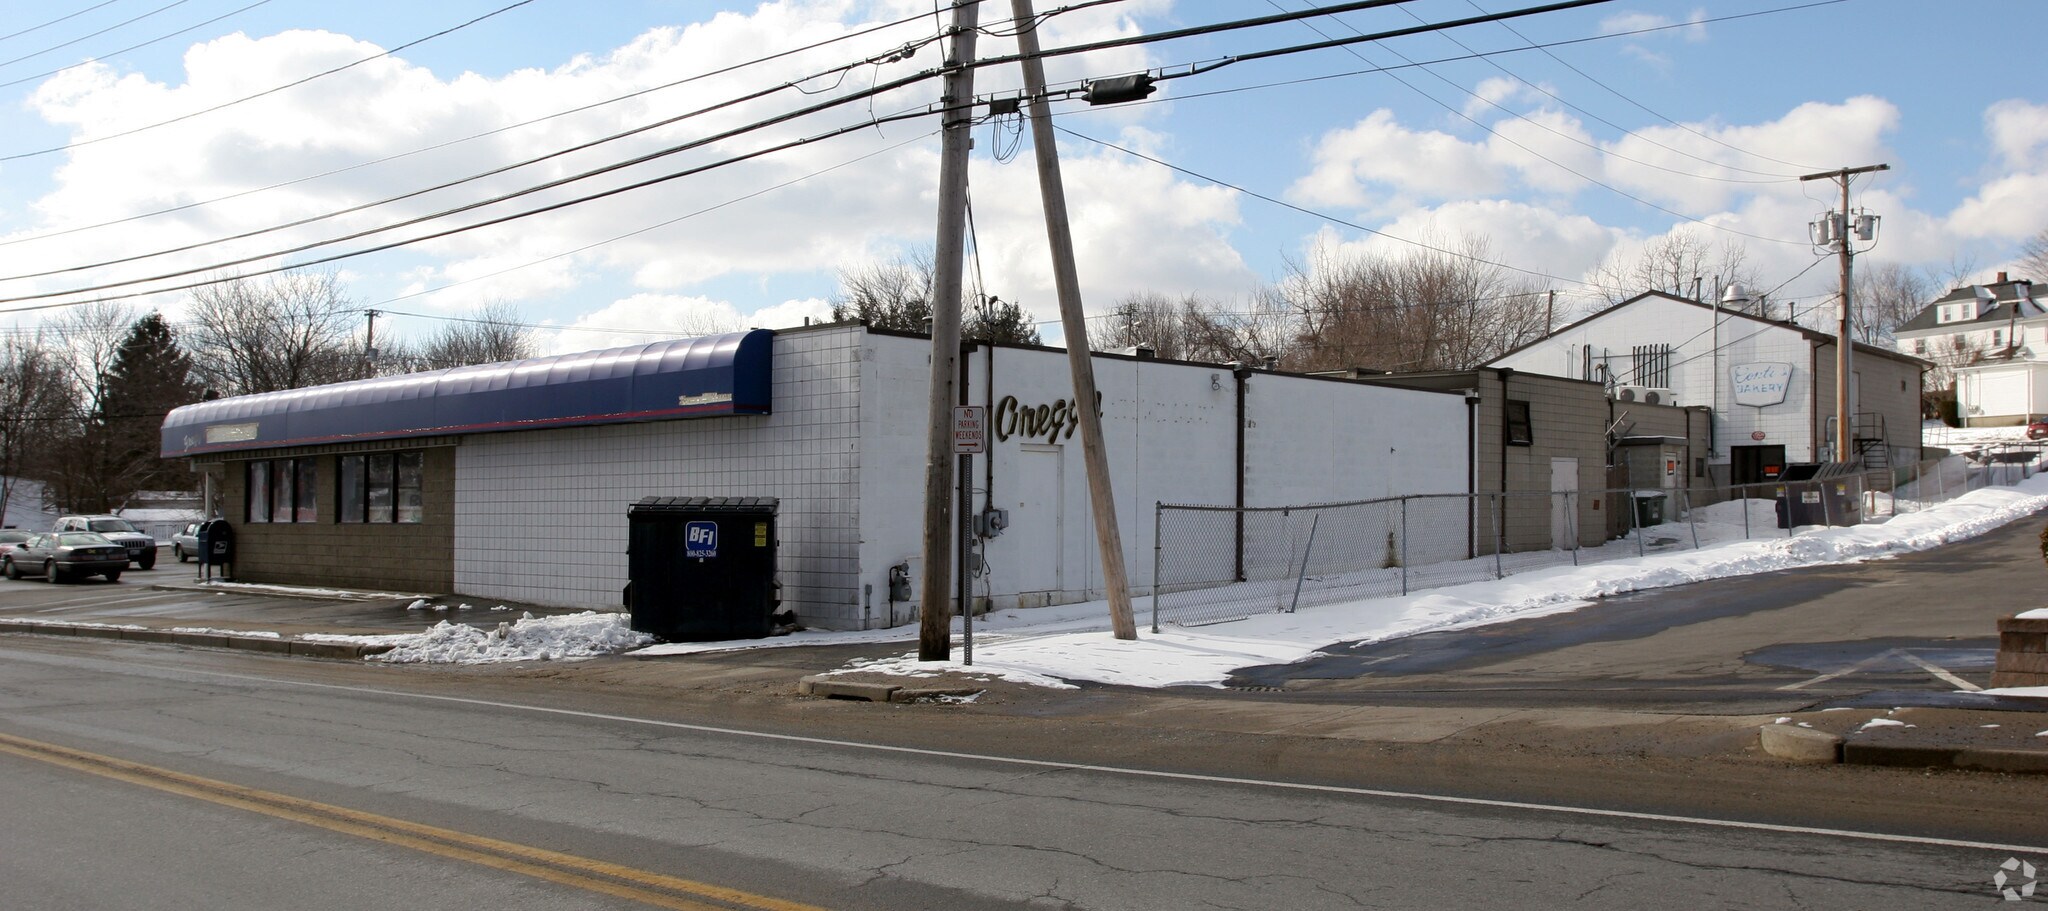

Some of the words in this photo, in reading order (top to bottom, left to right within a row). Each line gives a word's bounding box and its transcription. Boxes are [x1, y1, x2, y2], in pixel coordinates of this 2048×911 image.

[963, 409, 974, 418] NO
[958, 420, 979, 429] PARKING
[955, 430, 982, 440] WEEKENDS
[689, 526, 714, 545] BFI
